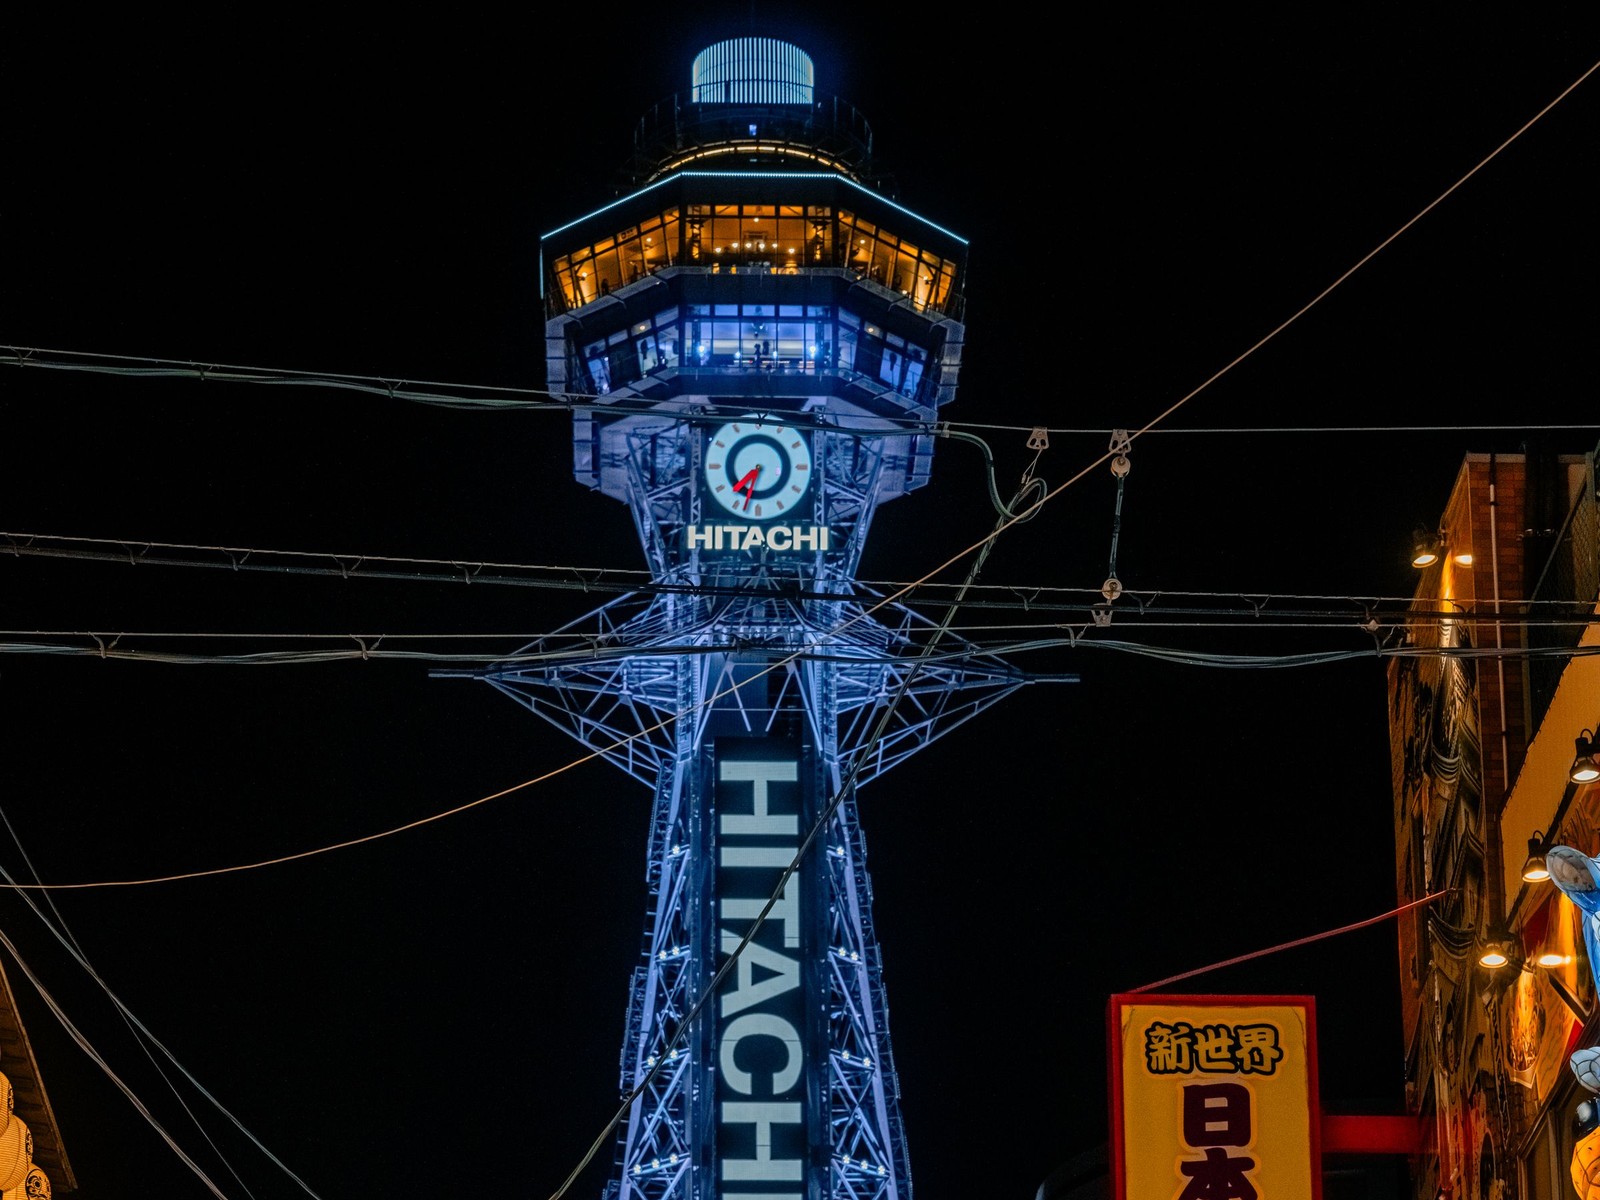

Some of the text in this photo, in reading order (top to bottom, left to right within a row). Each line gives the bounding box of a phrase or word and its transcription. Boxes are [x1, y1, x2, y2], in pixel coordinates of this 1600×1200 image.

[687, 525, 829, 551] HITACHI
[1145, 1021, 1284, 1075] 新世界
